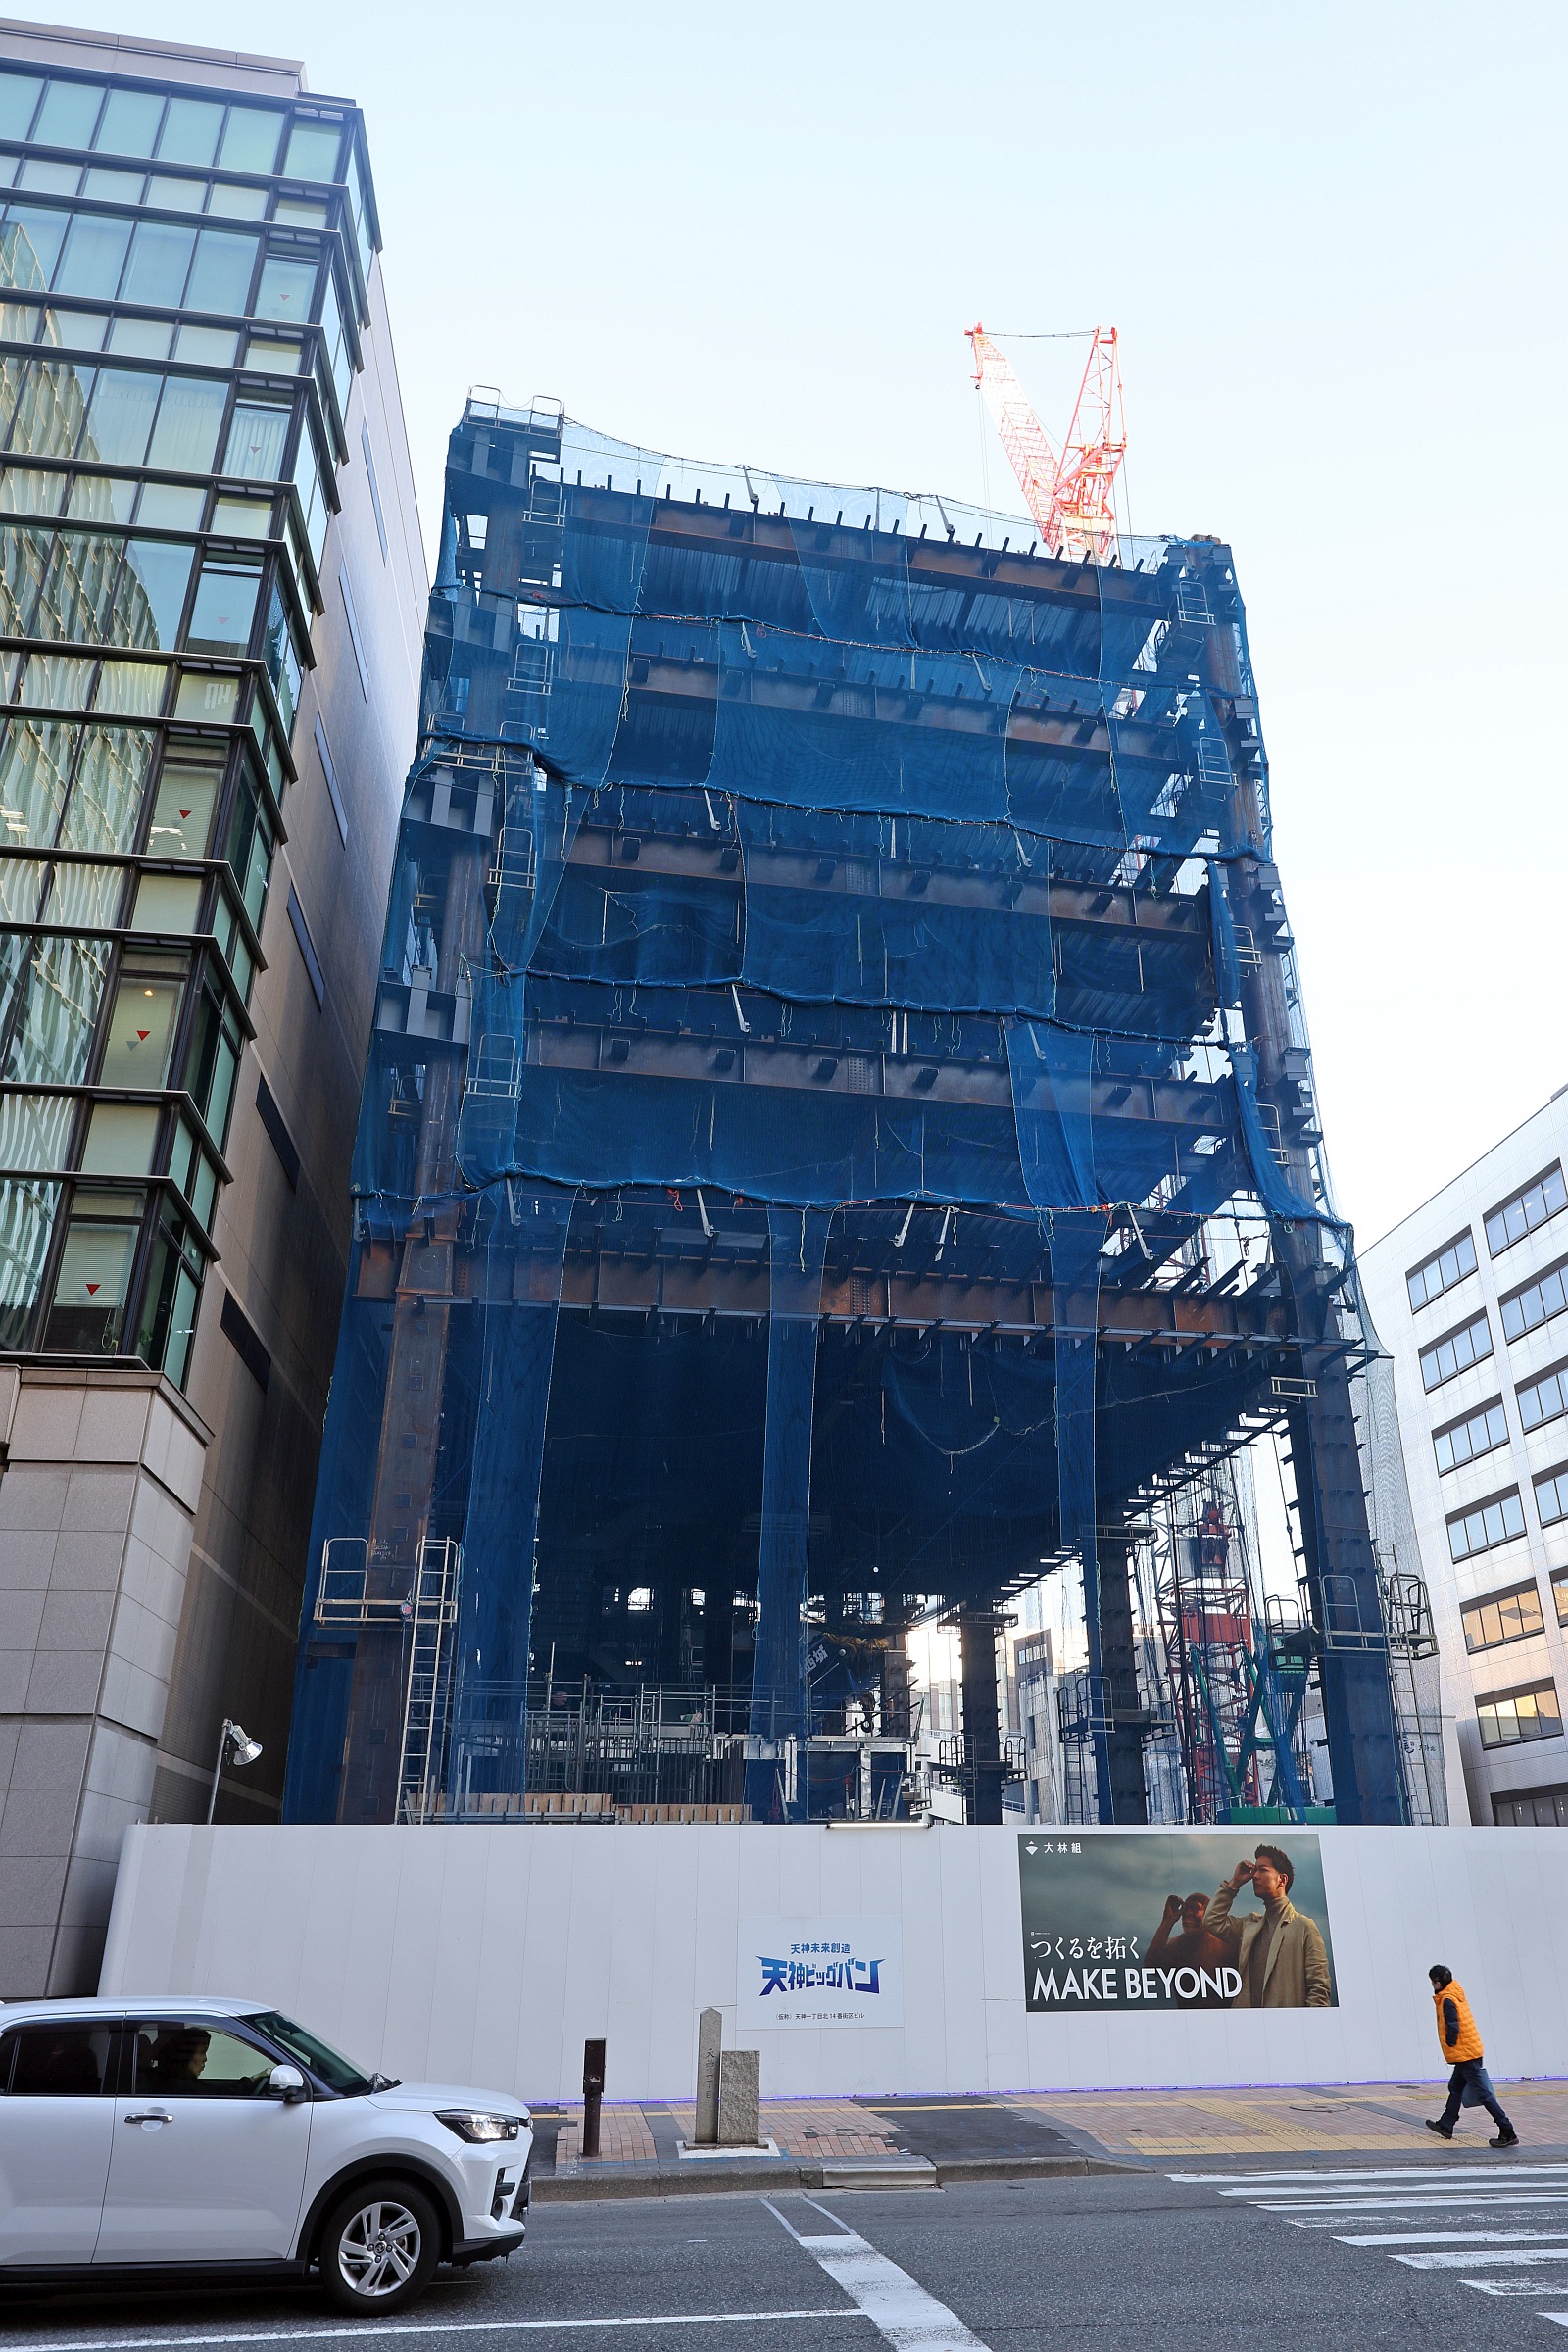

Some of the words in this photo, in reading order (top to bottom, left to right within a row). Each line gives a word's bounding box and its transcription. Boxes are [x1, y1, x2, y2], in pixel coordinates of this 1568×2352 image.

[1044, 1842, 1082, 1854] 大林組
[790, 1942, 851, 1954] 天神未来創造
[1030, 1936, 1140, 1960] つくるを拓く
[755, 1955, 886, 1997] 天神ビッグバン
[1032, 1967, 1118, 2001] MAKE
[1125, 1966, 1243, 1999] BEYOND
